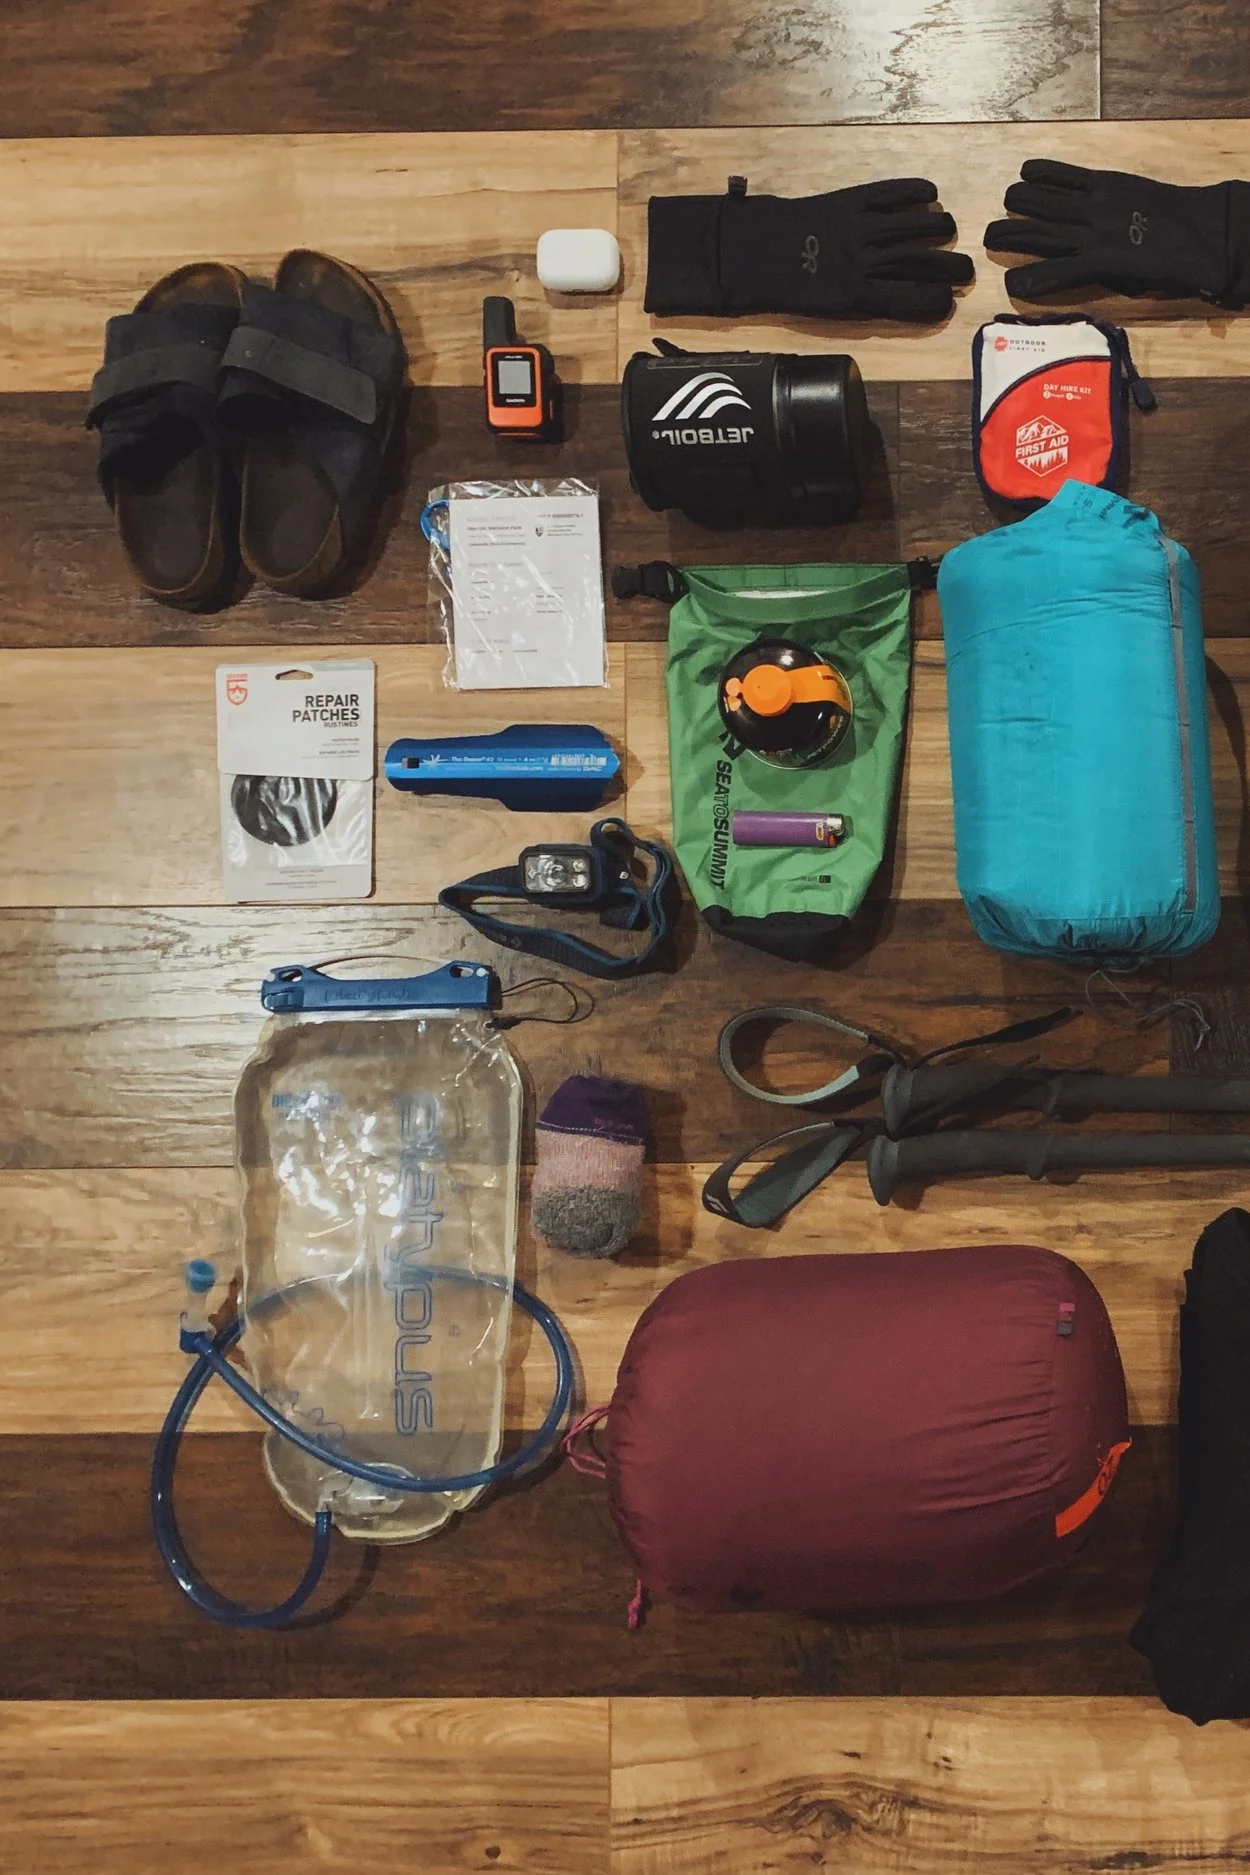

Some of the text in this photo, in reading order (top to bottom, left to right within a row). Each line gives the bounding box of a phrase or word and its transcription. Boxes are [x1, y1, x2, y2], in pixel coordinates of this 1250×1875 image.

[1043, 383, 1058, 391] DAY
[1015, 435, 1069, 459] FIRST AID
[305, 694, 359, 708] REPAIR
[292, 708, 360, 722] PATCHES
